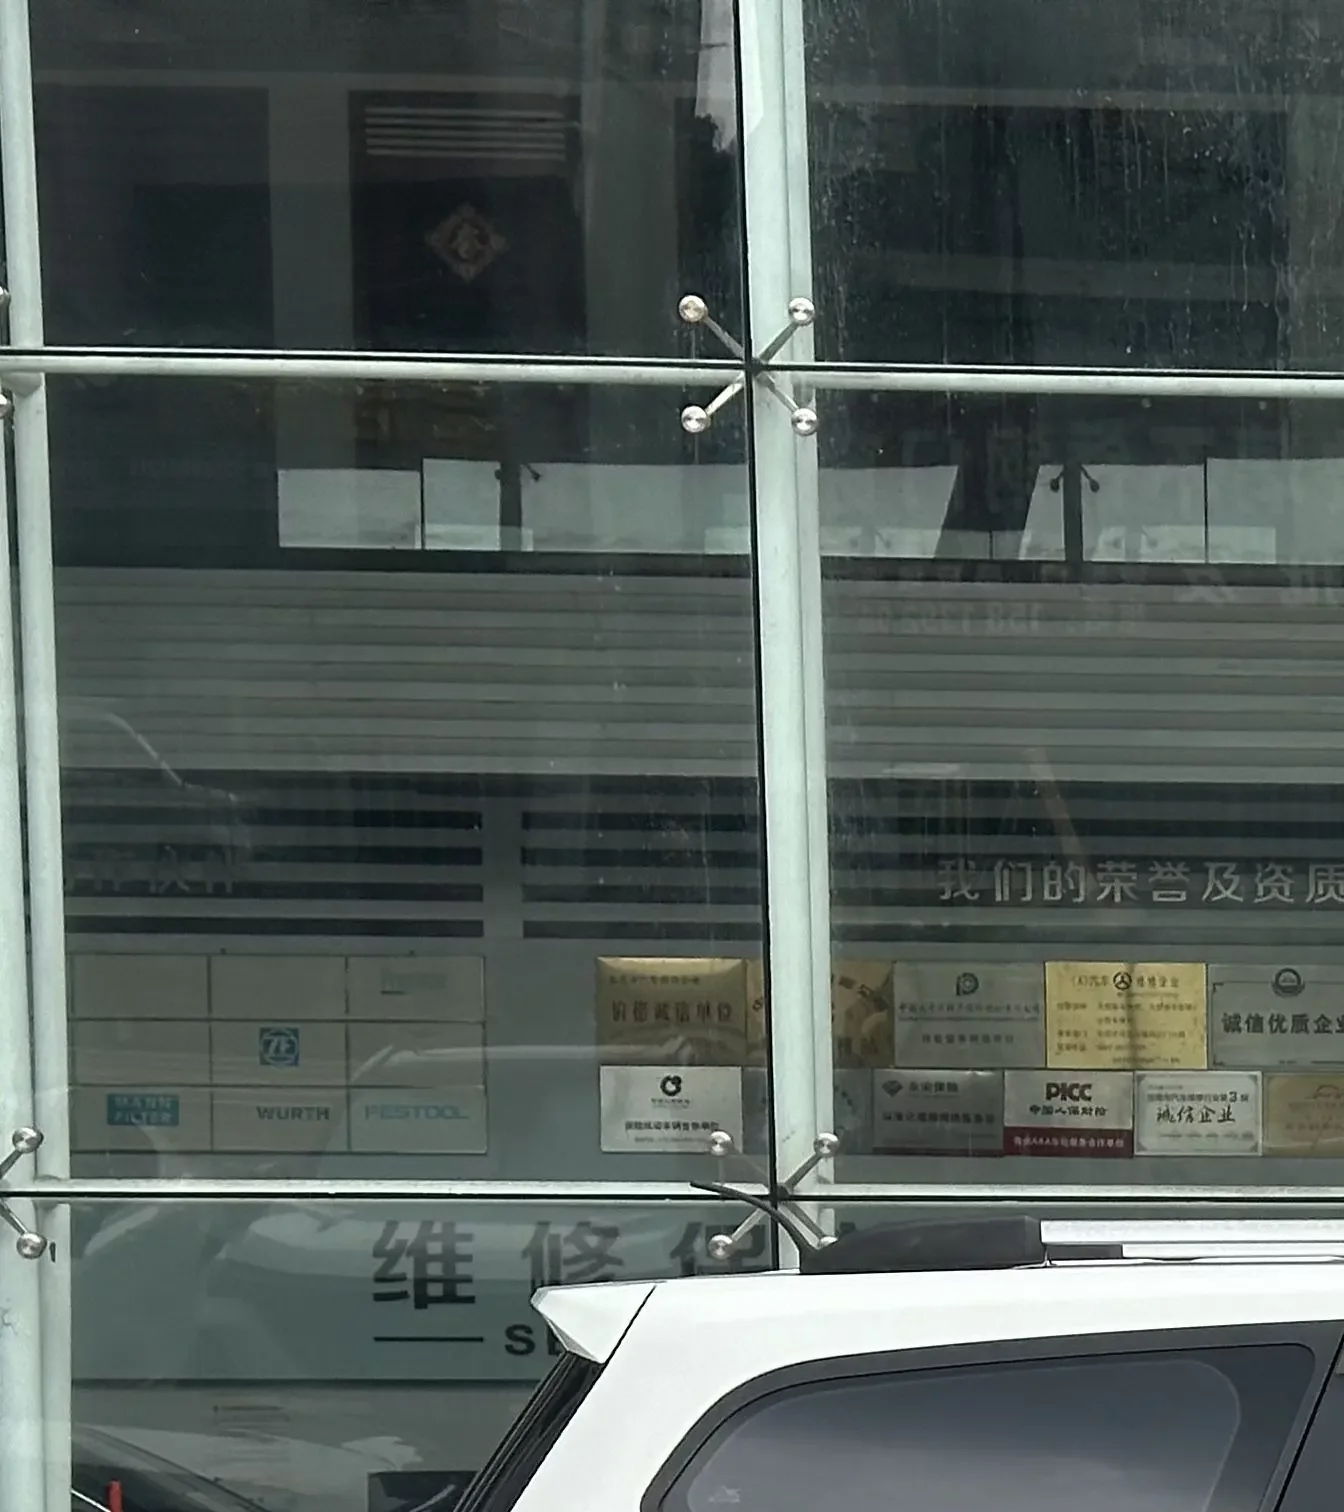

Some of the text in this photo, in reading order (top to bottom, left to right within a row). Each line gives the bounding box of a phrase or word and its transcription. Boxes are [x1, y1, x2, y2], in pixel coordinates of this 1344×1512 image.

[1045, 1082, 1092, 1102] PICC
[1156, 1103, 1236, 1124] 诚信企业
